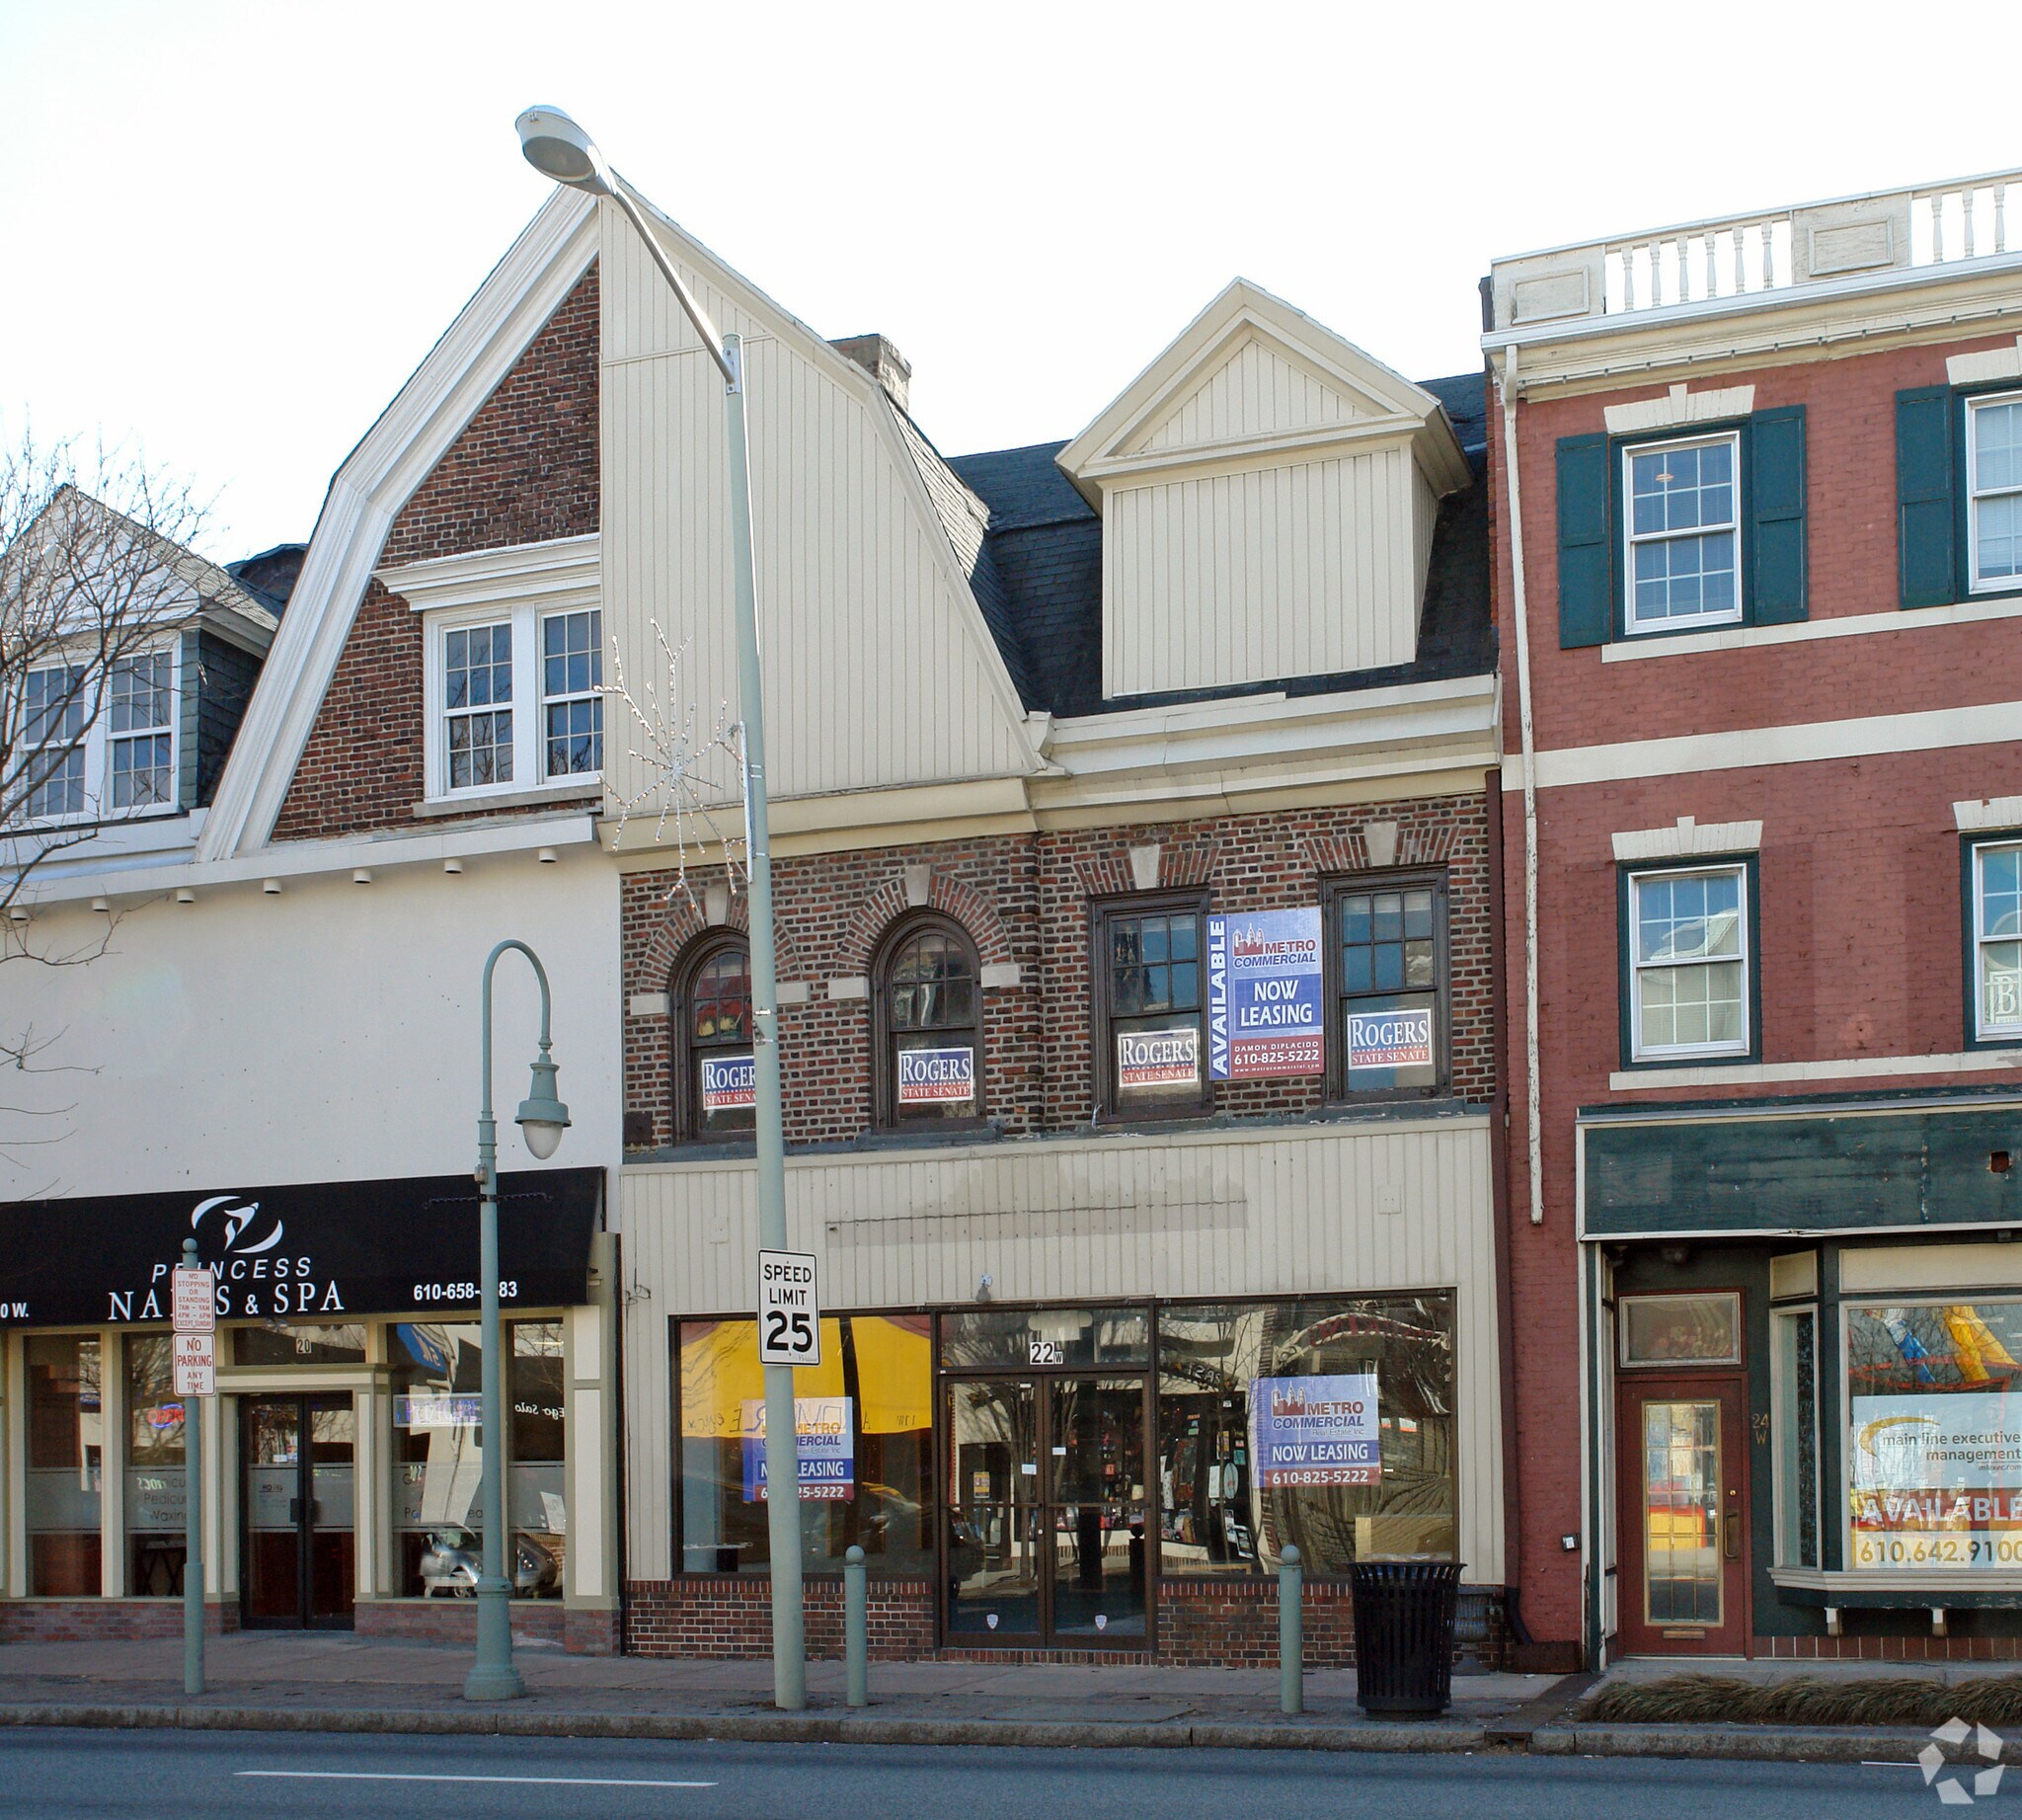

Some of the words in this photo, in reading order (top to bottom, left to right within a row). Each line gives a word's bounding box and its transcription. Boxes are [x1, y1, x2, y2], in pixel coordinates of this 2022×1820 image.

[1265, 939, 1316, 954] METRO
[1234, 953, 1316, 968] COMMERCIAL
[1209, 920, 1228, 1076] AVAILABLE
[1254, 980, 1299, 1001] NOW
[1240, 1003, 1313, 1027] LEASING
[1351, 1019, 1428, 1047] ROGERS
[1122, 1038, 1194, 1066] ROGERS
[1234, 1044, 1268, 1053] DAMON
[1234, 1049, 1319, 1066] 610-825-5222
[1352, 1053, 1384, 1065] STATE
[1386, 1050, 1429, 1062] SENATE
[901, 1055, 971, 1082] ROGERS
[1123, 1071, 1153, 1082] STATE
[1155, 1068, 1194, 1079] SENATE
[1234, 1064, 1320, 1072] www.metrocommercial.com
[704, 1063, 757, 1089] ROGER
[706, 1094, 733, 1105] STATE
[902, 1088, 931, 1098] STATE
[933, 1086, 970, 1096] SENATE
[151, 1257, 312, 1284] PNCESS
[763, 1263, 813, 1284] SPEED
[414, 1281, 517, 1301] 610-658-83
[769, 1287, 807, 1306] LIMIT
[107, 1286, 231, 1321] NAS
[245, 1294, 260, 1315] &
[273, 1280, 346, 1315] SPA
[12, 1303, 30, 1318] W.
[766, 1309, 814, 1353] 25
[187, 1339, 202, 1351] NO
[297, 1339, 311, 1354] 20
[177, 1355, 212, 1367] PARKING
[187, 1382, 204, 1390] TIME
[147, 1408, 186, 1423] OPEN
[1307, 1401, 1364, 1415] METRO
[1273, 1416, 1364, 1430] COMMERCIAL
[1752, 1413, 1769, 1429] 24
[1755, 1430, 1767, 1445] W
[1883, 1433, 1917, 1446] main
[1921, 1432, 1948, 1445] line
[1952, 1431, 2022, 1445] executive
[1272, 1445, 1308, 1462] NOW
[1311, 1443, 1368, 1461] LEASING
[1925, 1448, 2022, 1464] management
[1272, 1469, 1368, 1484] 610-825-5222
[1860, 1496, 2022, 1522] AVAILABLE
[1860, 1540, 2022, 1562] 610.642.9100
